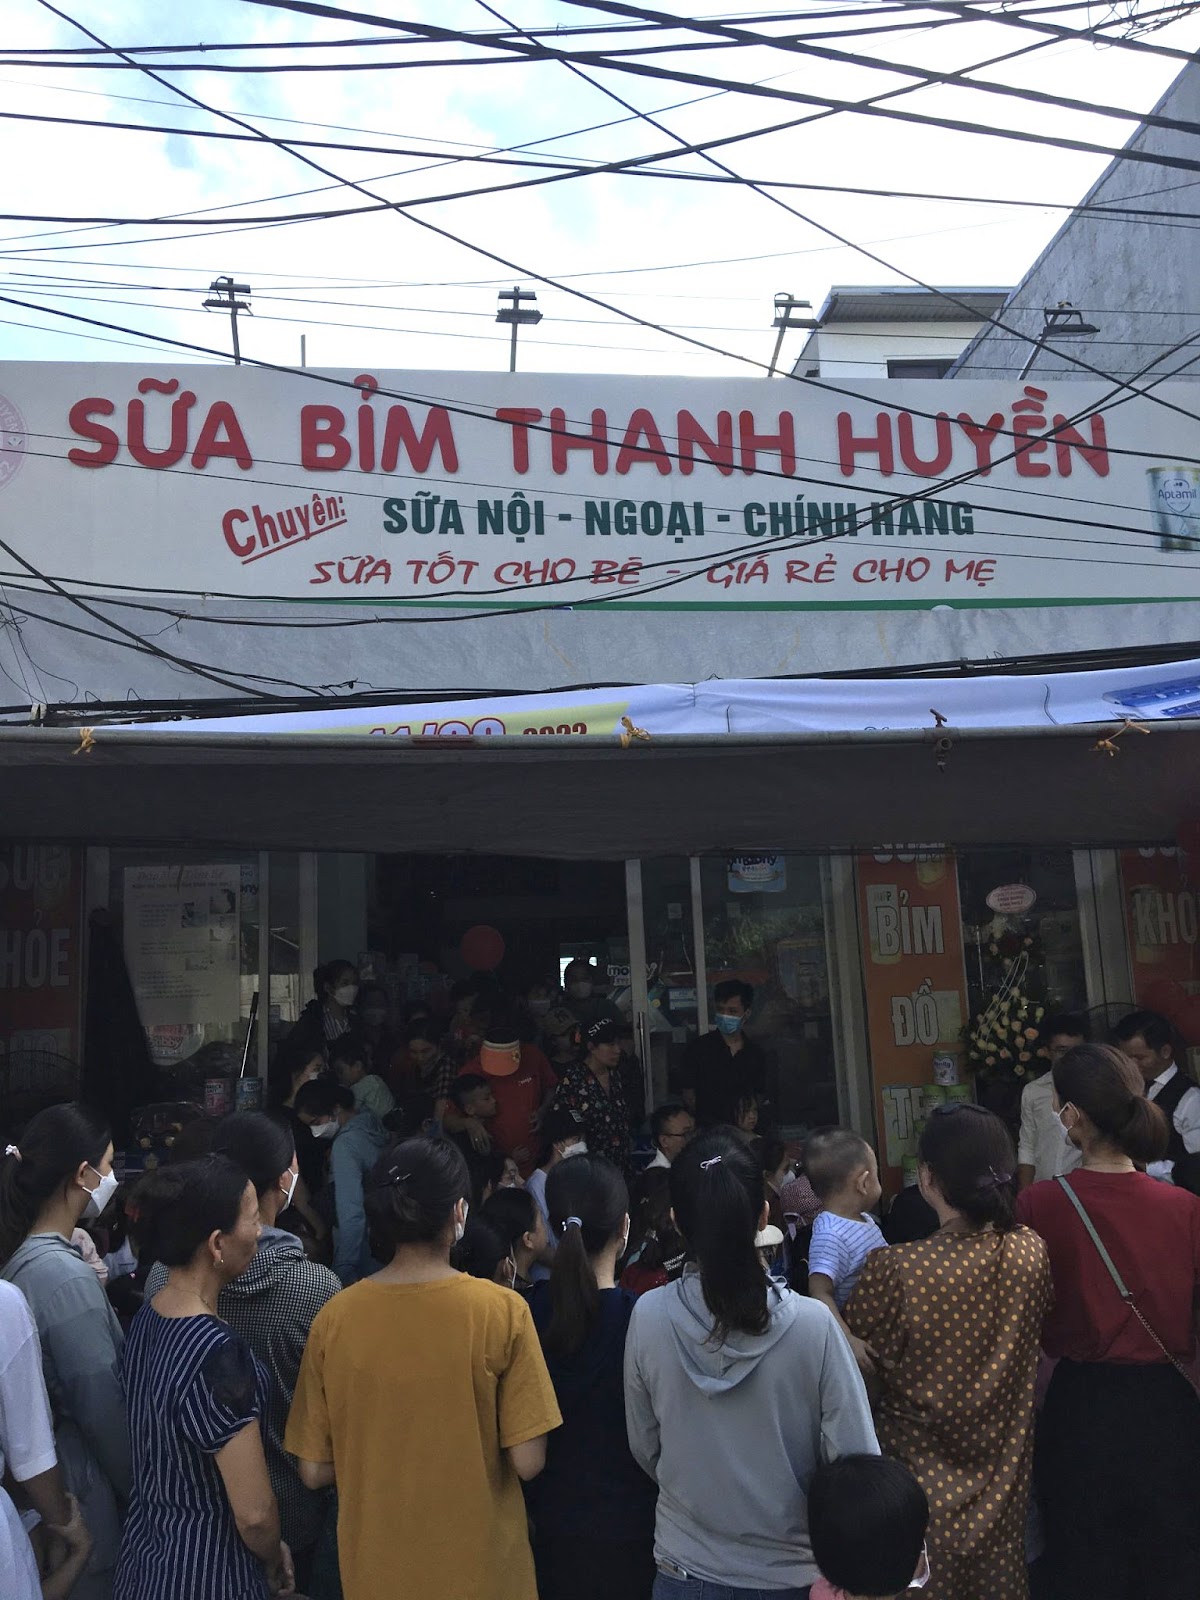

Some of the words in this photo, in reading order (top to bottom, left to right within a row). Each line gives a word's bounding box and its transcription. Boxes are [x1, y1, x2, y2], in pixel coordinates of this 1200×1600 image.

[68, 378, 253, 470] SỮA
[301, 374, 459, 473] BỈM
[496, 408, 796, 477] THANH
[837, 386, 1110, 477] HUYỀN
[222, 493, 346, 557] Chuyên:
[383, 491, 464, 535] SỮA
[477, 491, 545, 543] NỘI
[584, 500, 705, 544] NGOẠI
[743, 494, 858, 536] CHÍNH
[1158, 488, 1197, 501] Aptamil
[309, 555, 392, 585] SỮA
[406, 550, 480, 585] TỐT
[494, 558, 576, 585] CHO
[706, 553, 770, 589] GIÁ
[785, 553, 837, 584] RẺ
[852, 557, 931, 583] CHO
[944, 558, 998, 587] MẸ
[876, 889, 945, 956] BỈM
[1134, 872, 1200, 945] KHỎ
[0, 907, 70, 988] HỎE
[891, 977, 940, 1046] ĐỒ
